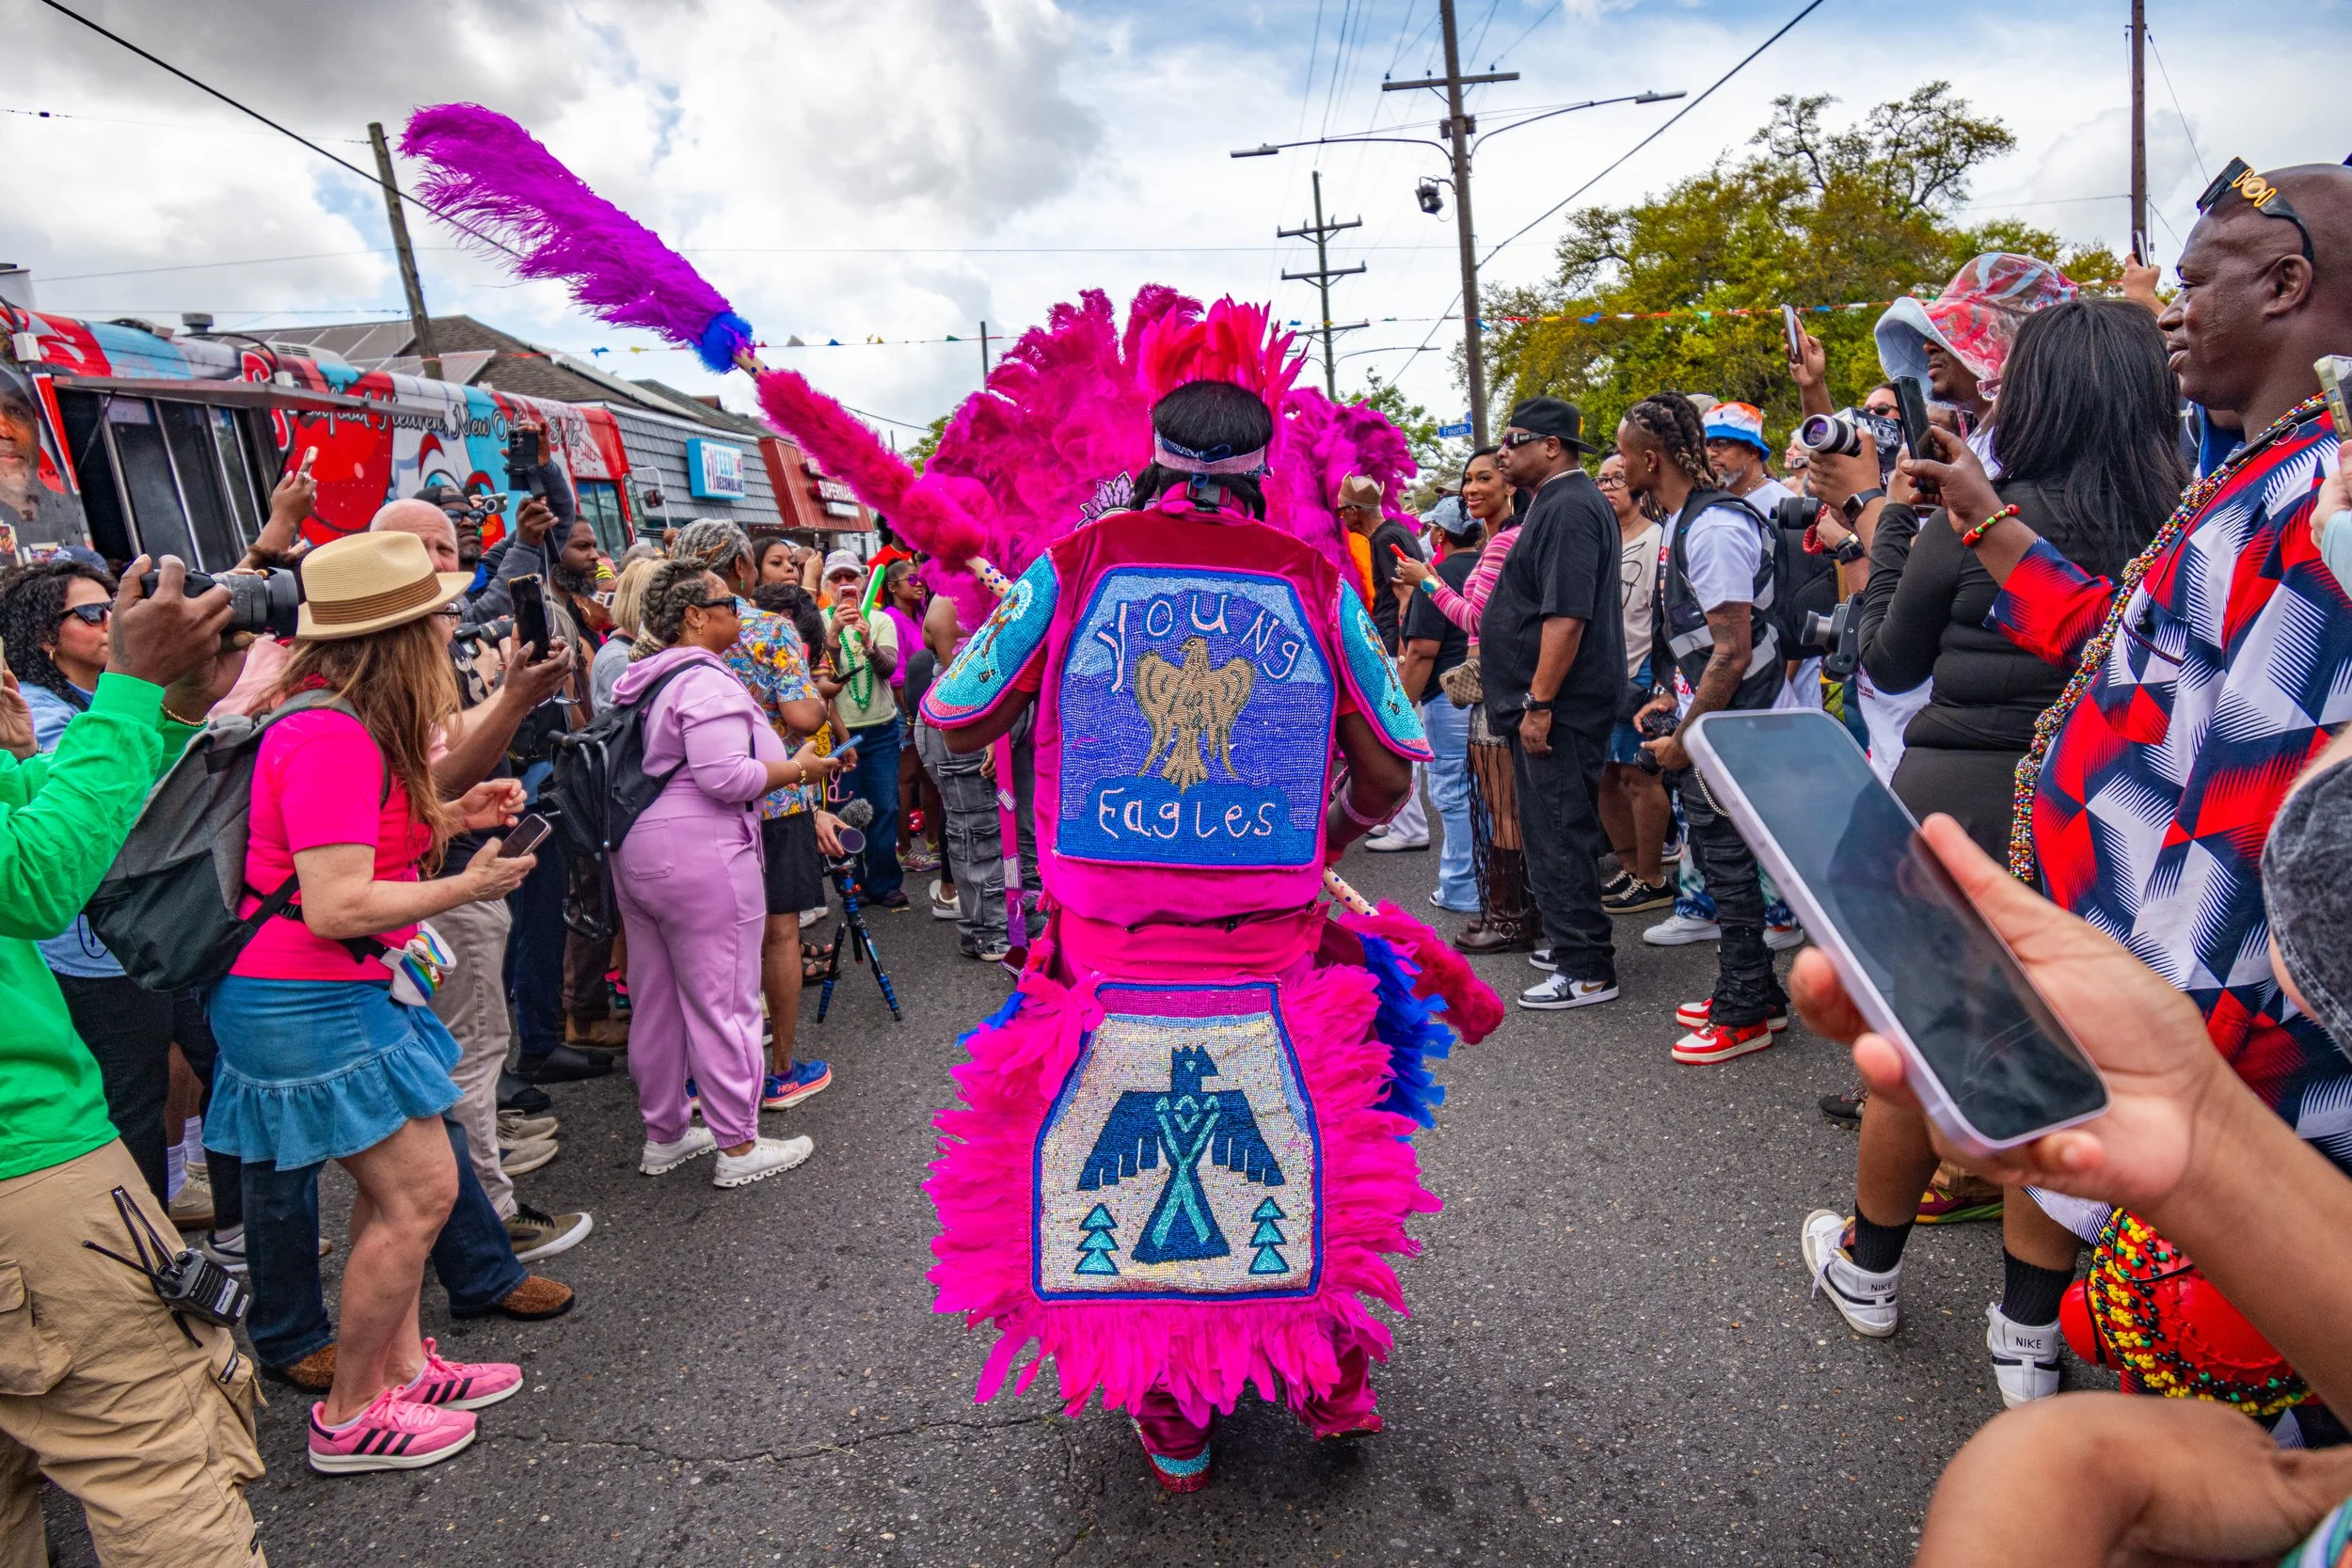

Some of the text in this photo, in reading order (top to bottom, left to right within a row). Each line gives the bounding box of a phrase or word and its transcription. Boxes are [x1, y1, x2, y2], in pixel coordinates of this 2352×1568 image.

[452, 403, 491, 440] New
[1443, 425, 1468, 436] Fourth
[1099, 787, 1276, 839] Eagles
[1870, 1281, 1893, 1291] NIKE
[2015, 1336, 2042, 1350] NIKE
